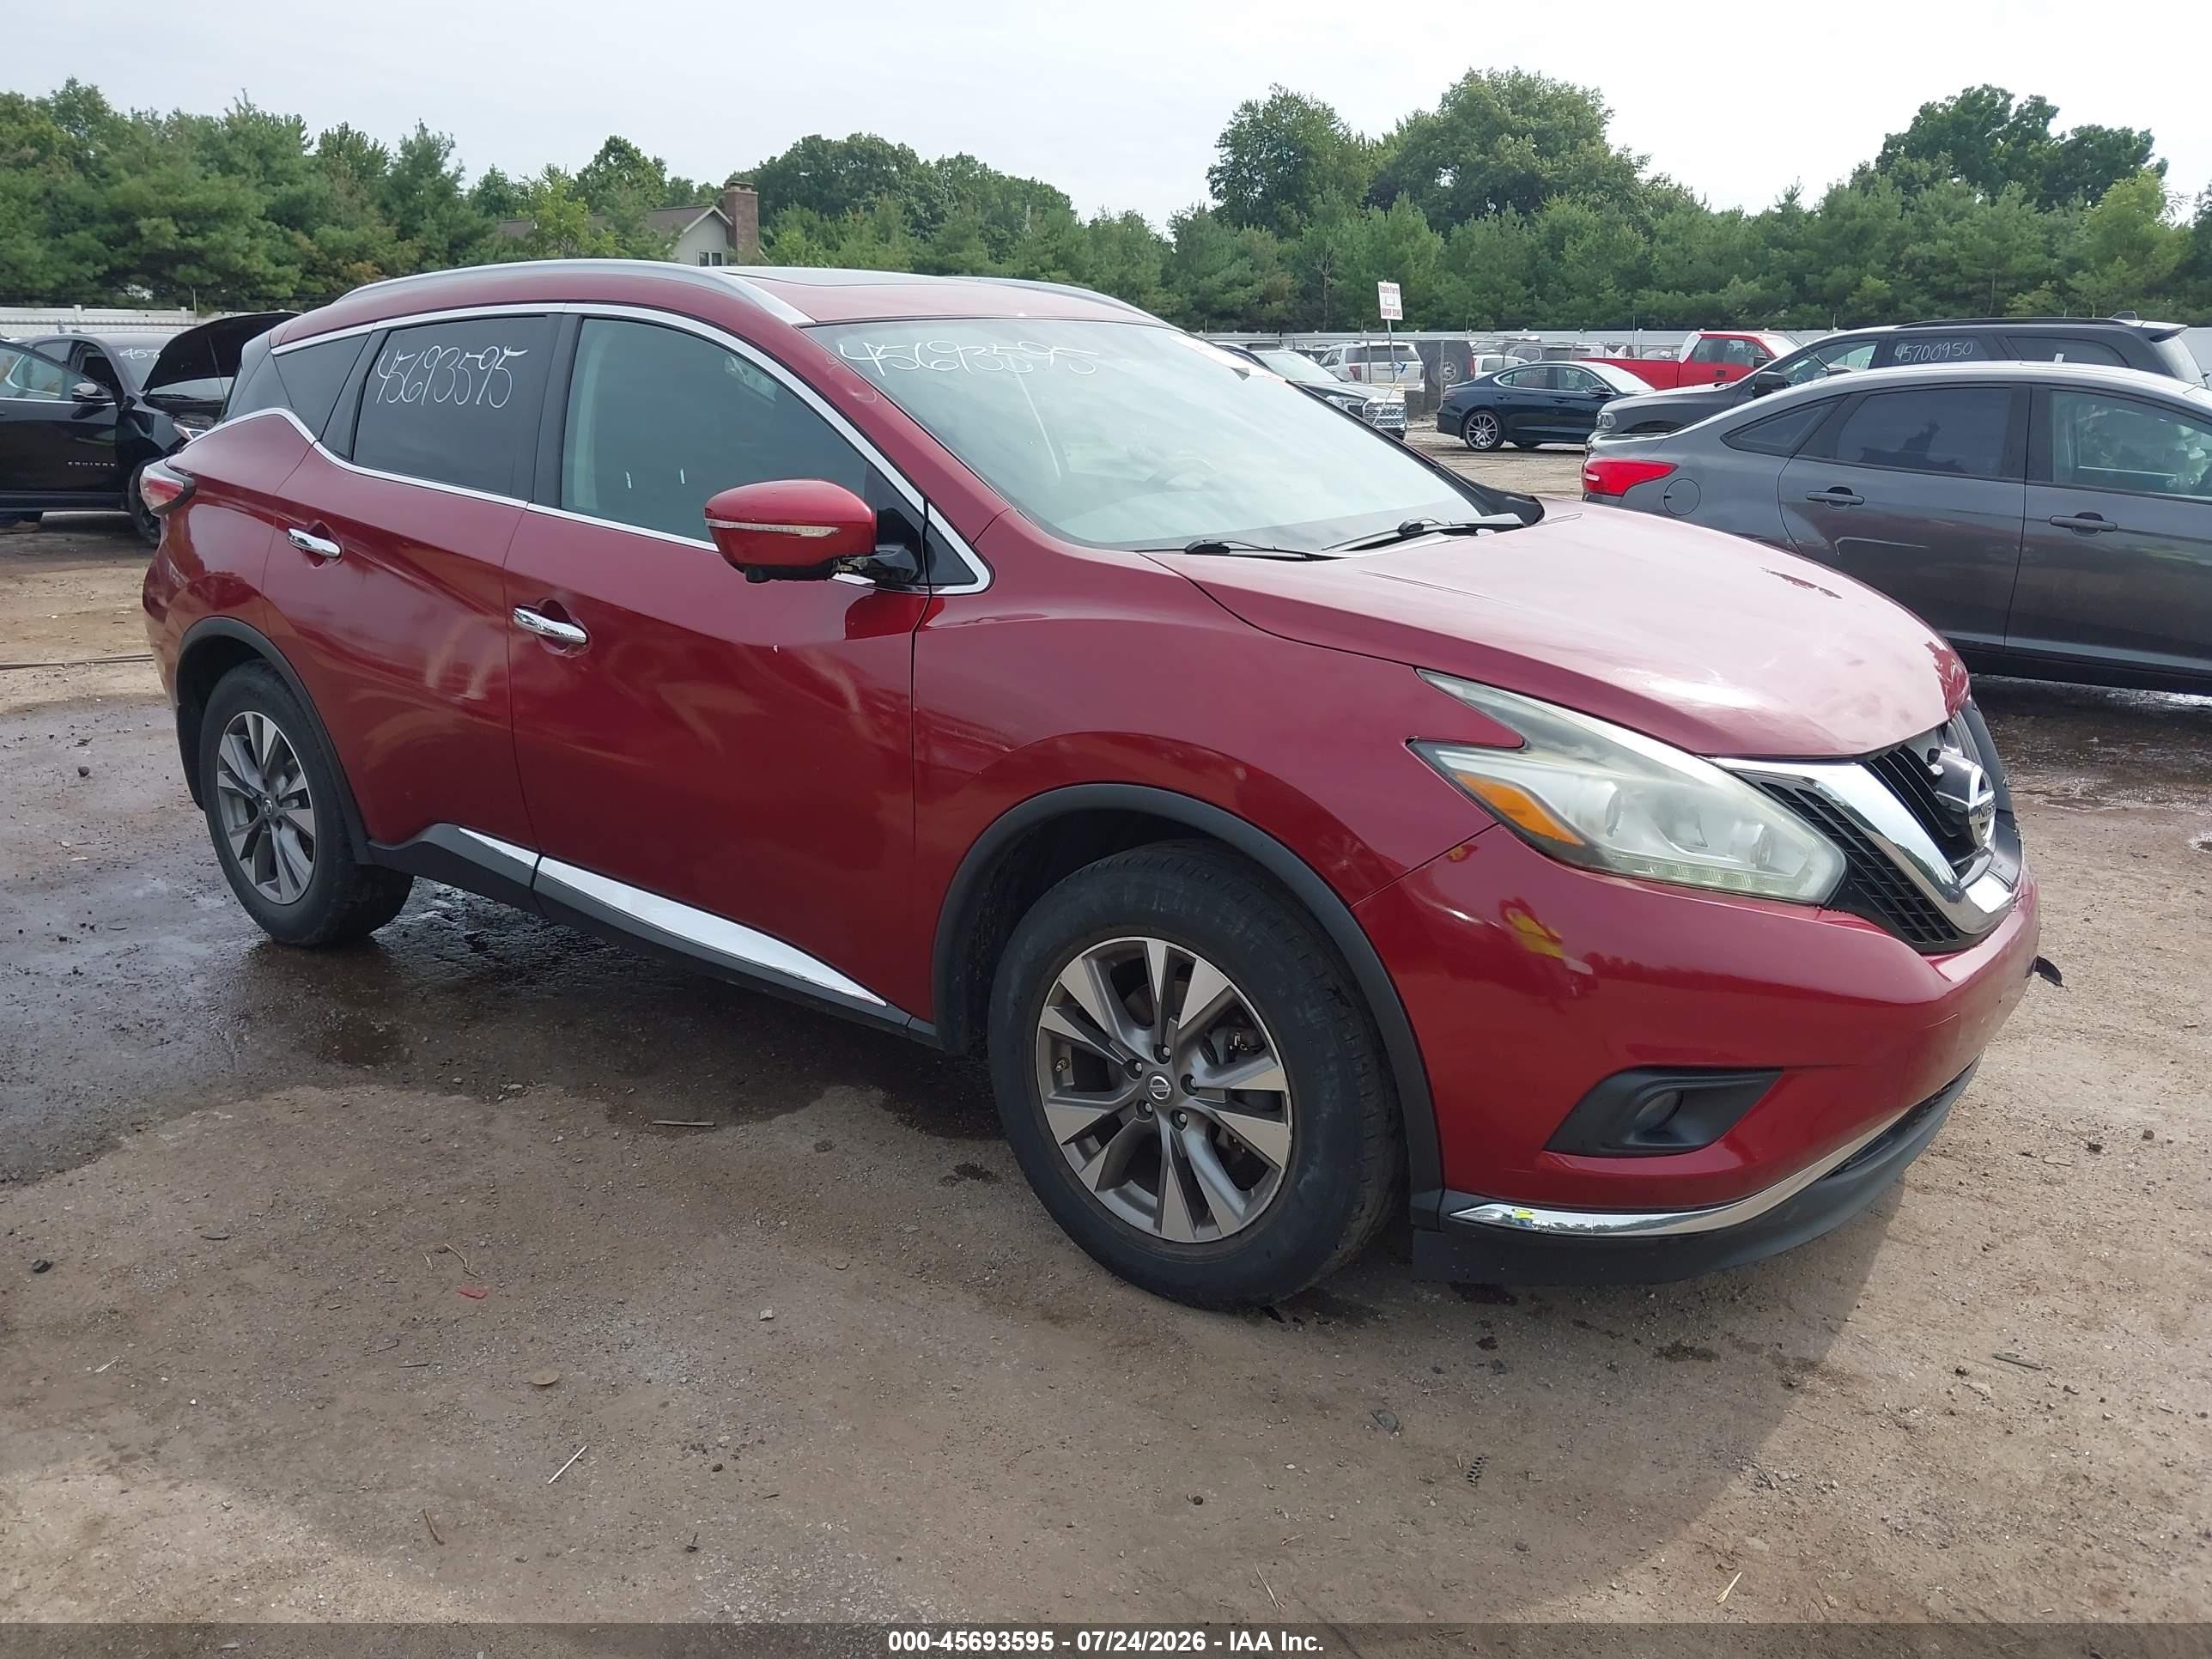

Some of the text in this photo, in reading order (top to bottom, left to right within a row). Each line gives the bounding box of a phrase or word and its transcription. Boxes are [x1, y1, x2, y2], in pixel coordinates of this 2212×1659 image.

[839, 340, 1099, 377] 45693595
[1894, 342, 1973, 362] 45700950
[376, 345, 529, 409] 45693595
